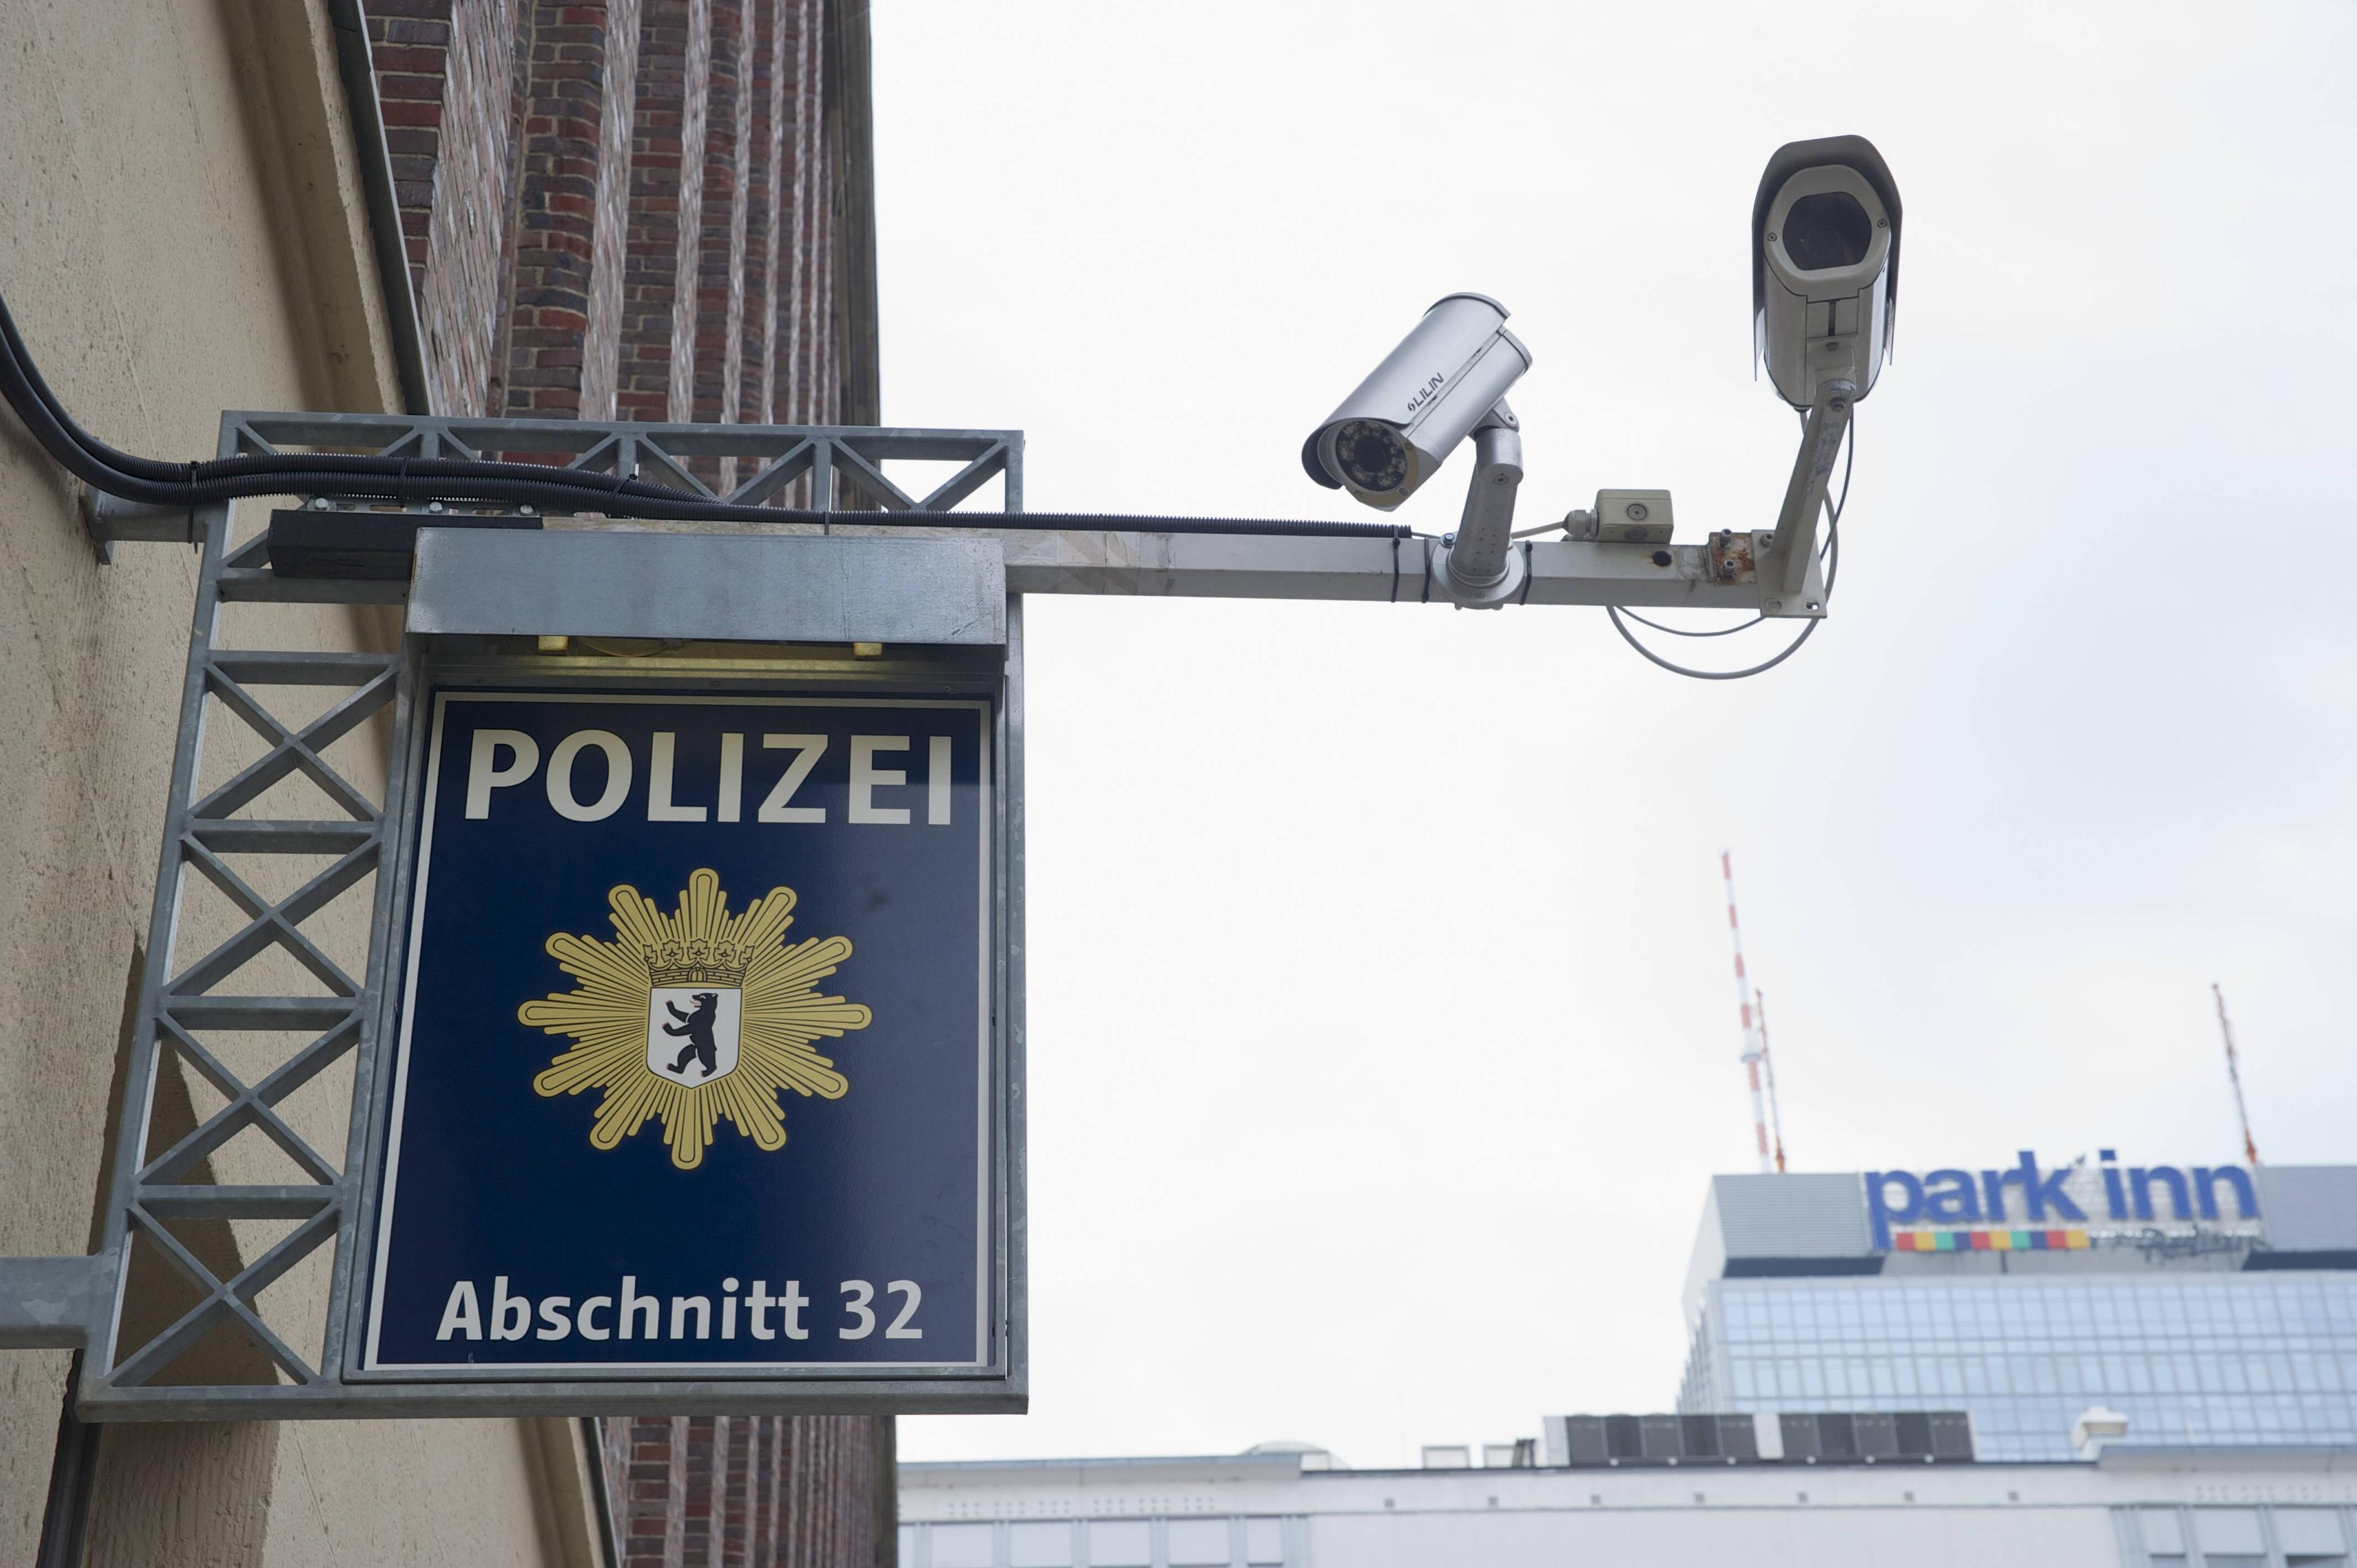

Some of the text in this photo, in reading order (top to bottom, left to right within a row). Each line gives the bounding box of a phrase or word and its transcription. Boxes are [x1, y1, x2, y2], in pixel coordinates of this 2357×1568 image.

[1412, 372, 1444, 407] LILIN
[465, 728, 952, 826] POLIZEI
[1864, 1148, 2261, 1251] park inn
[435, 1275, 923, 1341] Abschnitt 32
